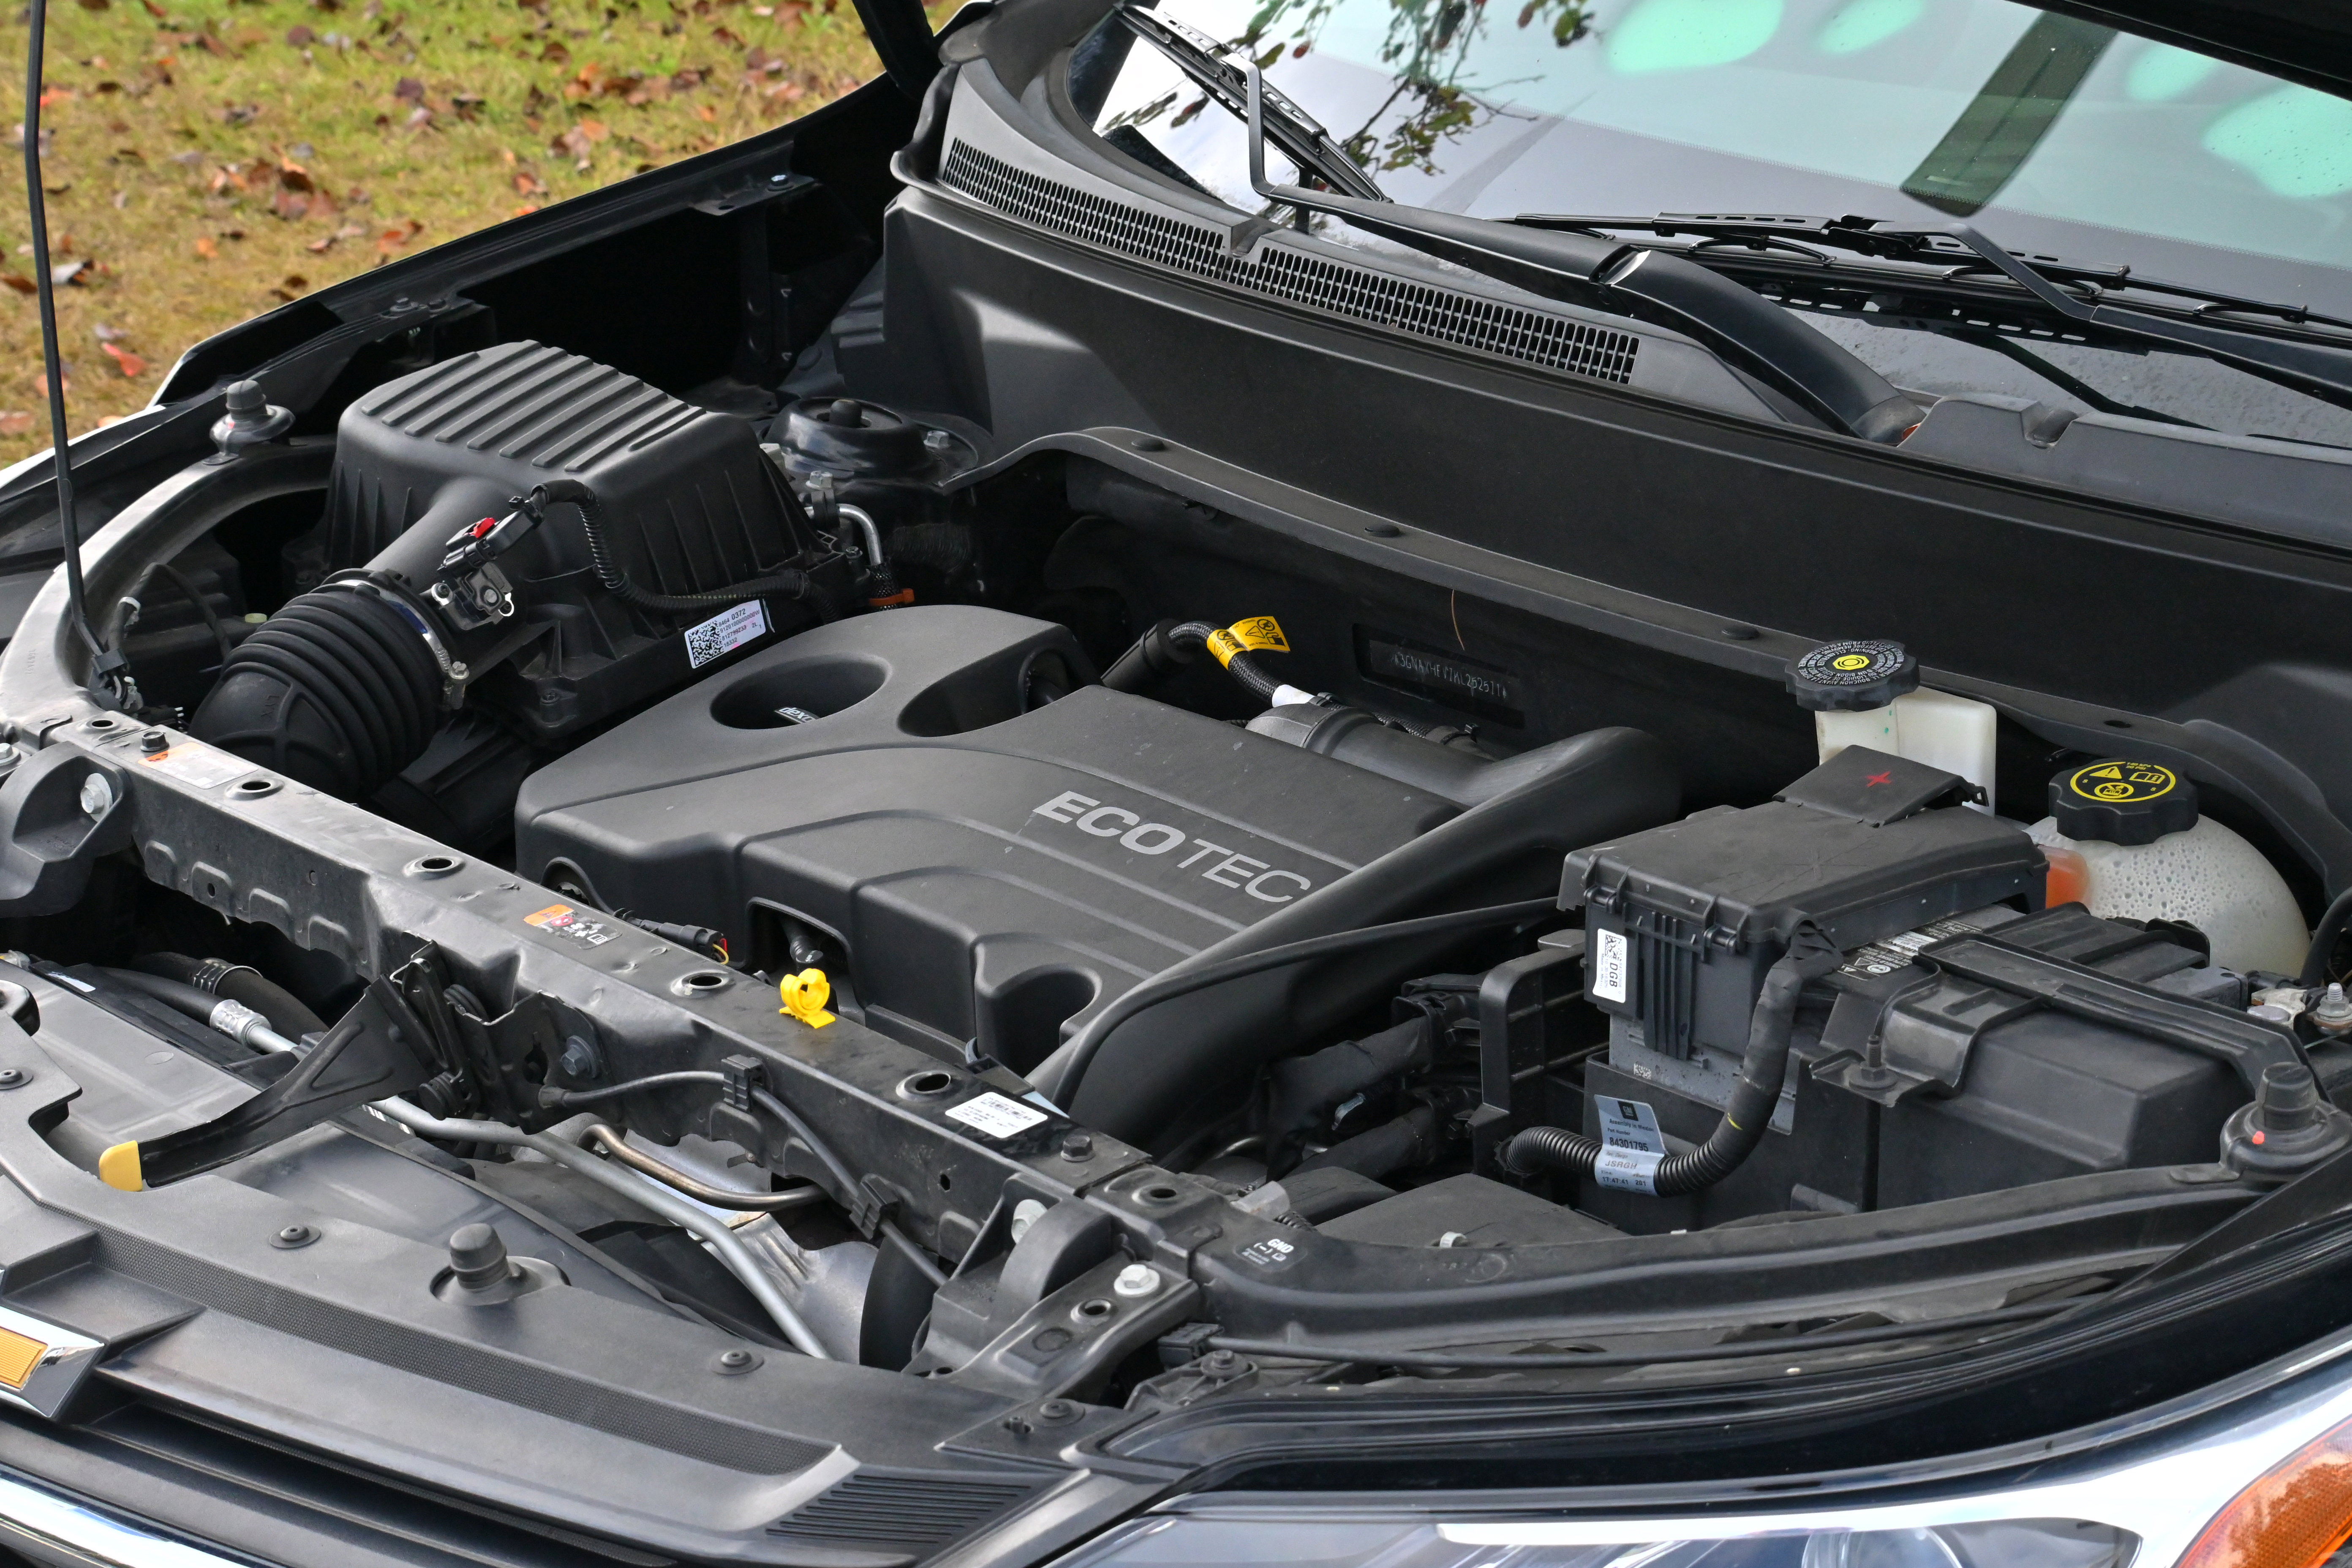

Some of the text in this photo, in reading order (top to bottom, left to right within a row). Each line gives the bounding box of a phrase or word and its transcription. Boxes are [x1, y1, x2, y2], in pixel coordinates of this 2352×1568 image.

[731, 608, 746, 620] 0372
[1815, 644, 1837, 653] SEALED
[1032, 790, 1311, 902] ECOTEC
[1609, 962, 1618, 988] DGB
[1609, 1137, 1649, 1152] 84301795
[1605, 1160, 1637, 1169] JSRGH
[1267, 1238, 1294, 1253] GND
